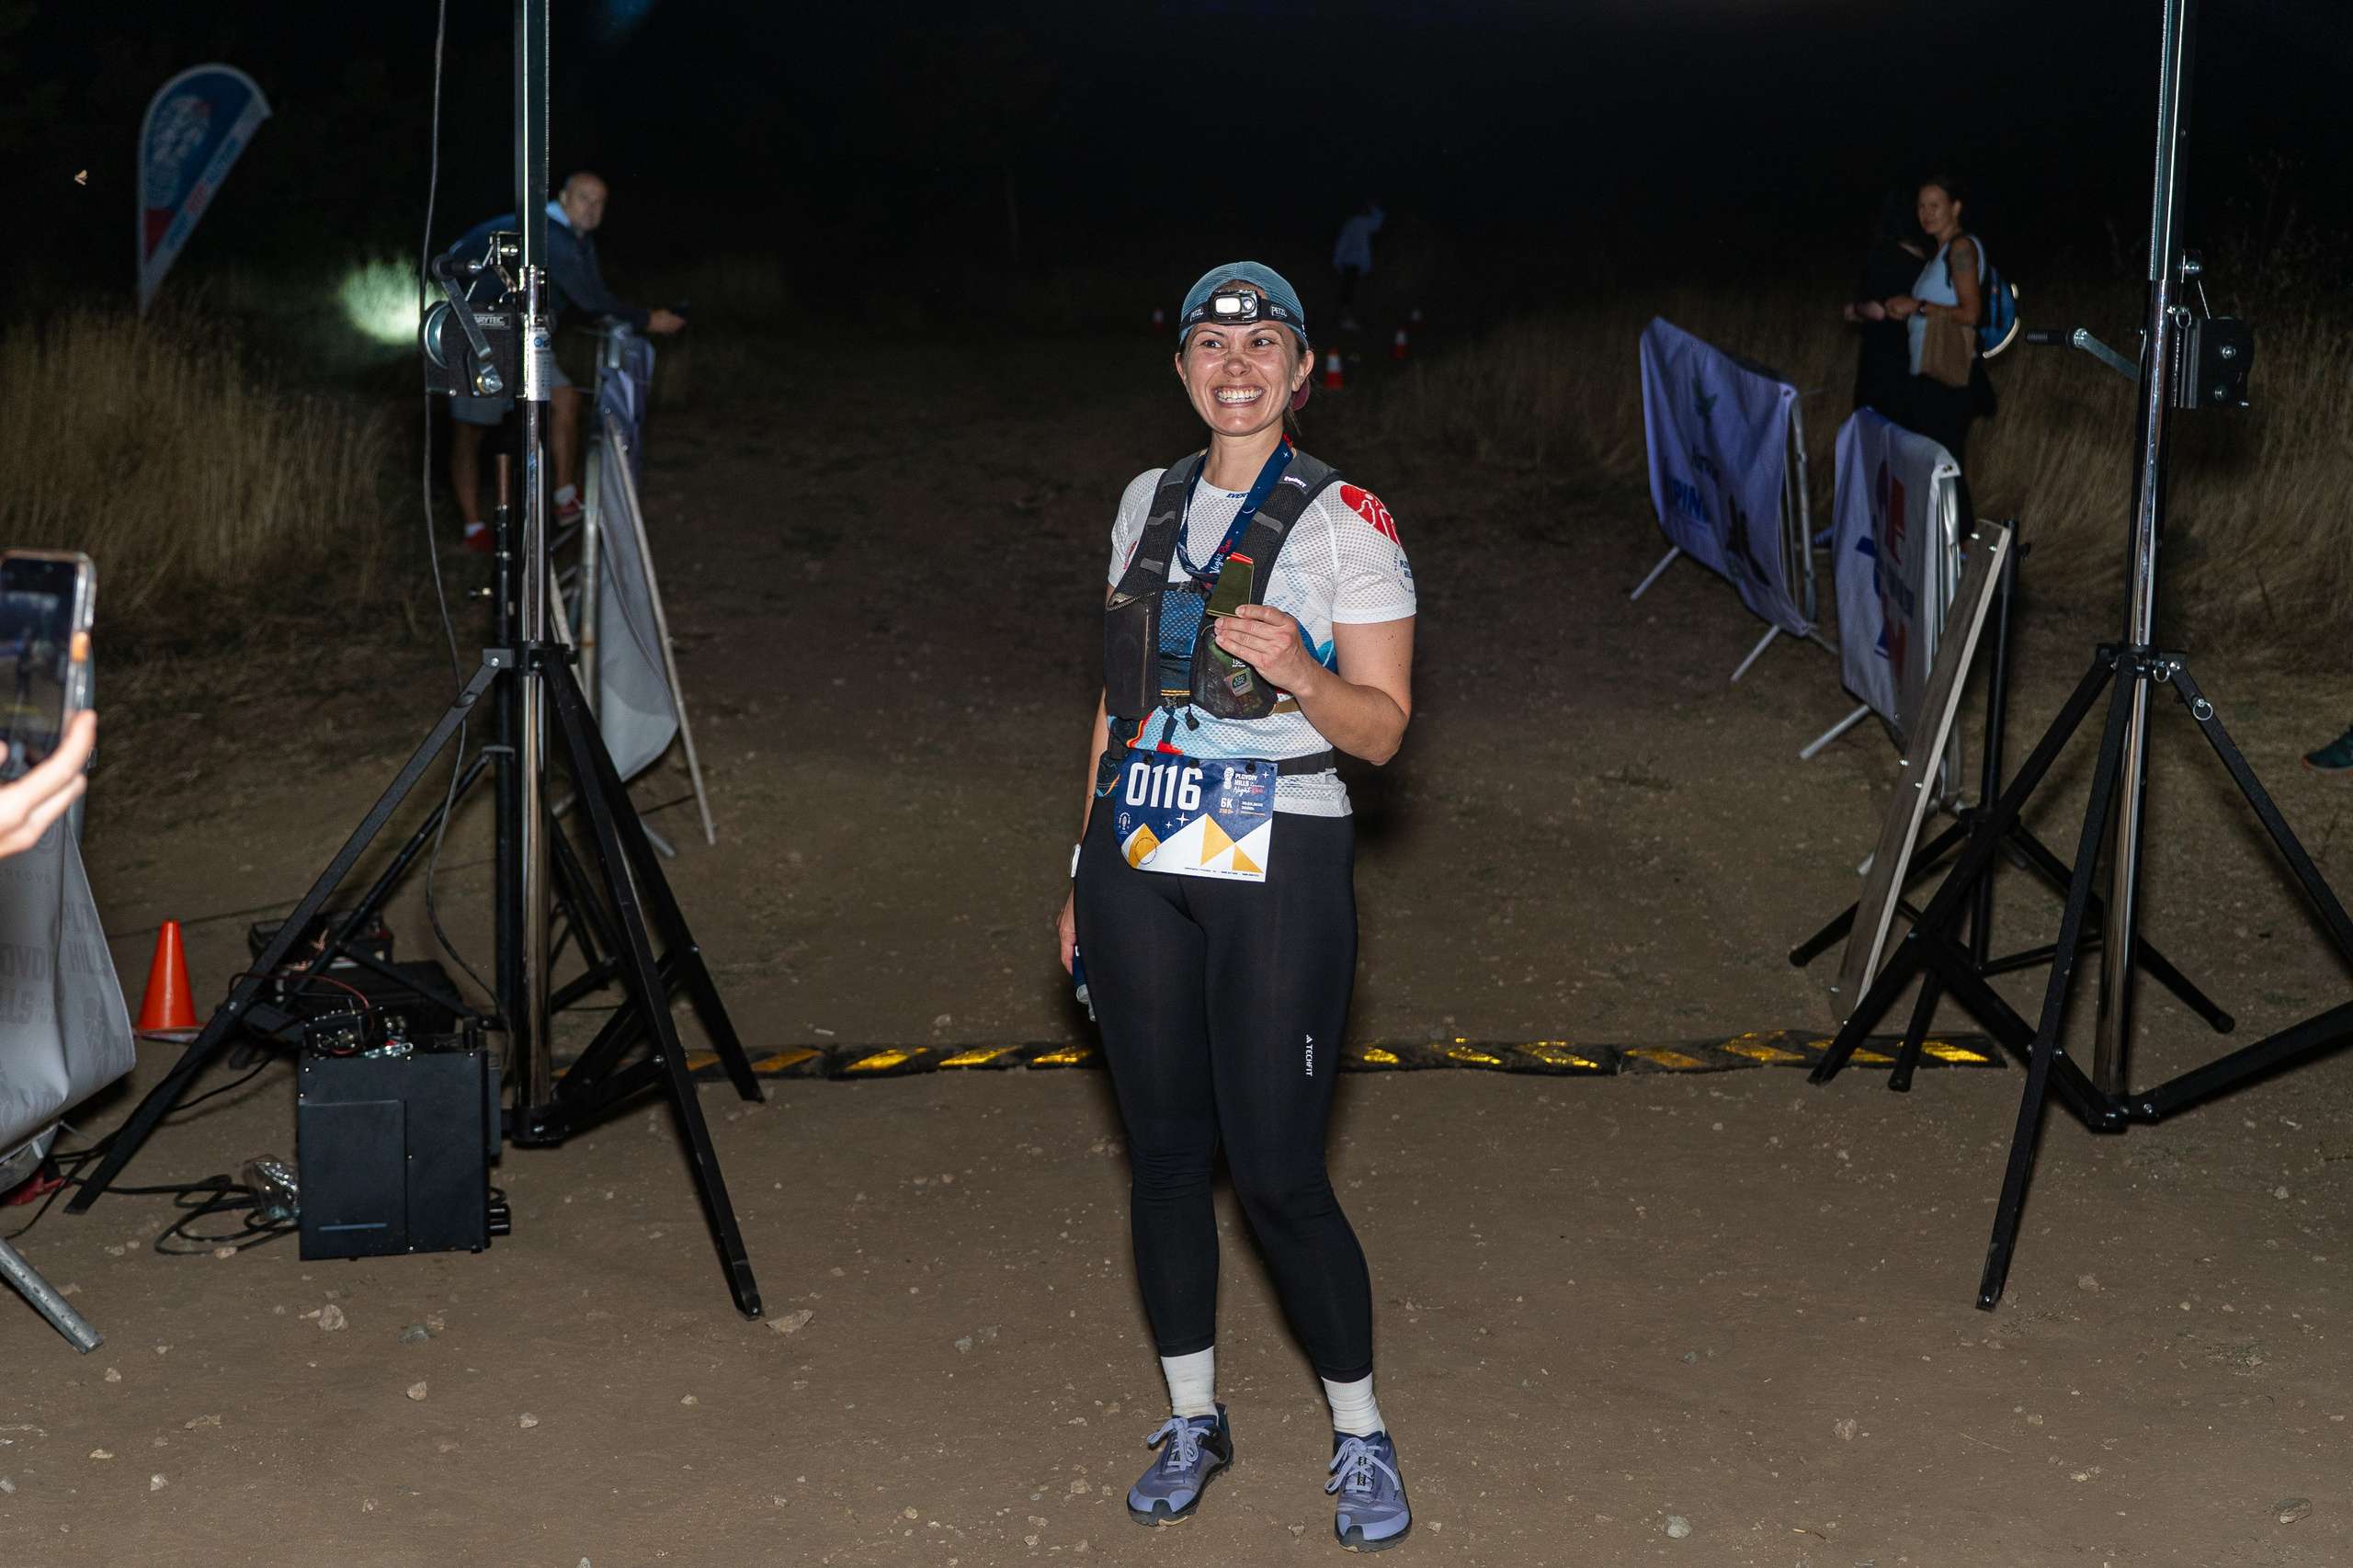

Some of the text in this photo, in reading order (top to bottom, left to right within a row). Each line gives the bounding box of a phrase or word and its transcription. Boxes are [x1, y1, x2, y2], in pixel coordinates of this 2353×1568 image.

[1271, 306, 1287, 318] PETZL
[1218, 539, 1233, 553] Run
[1235, 773, 1257, 781] PLOVDIV
[1126, 763, 1203, 811] 0116
[1221, 797, 1233, 808] 6K
[1305, 1044, 1313, 1076] TECHFIT
